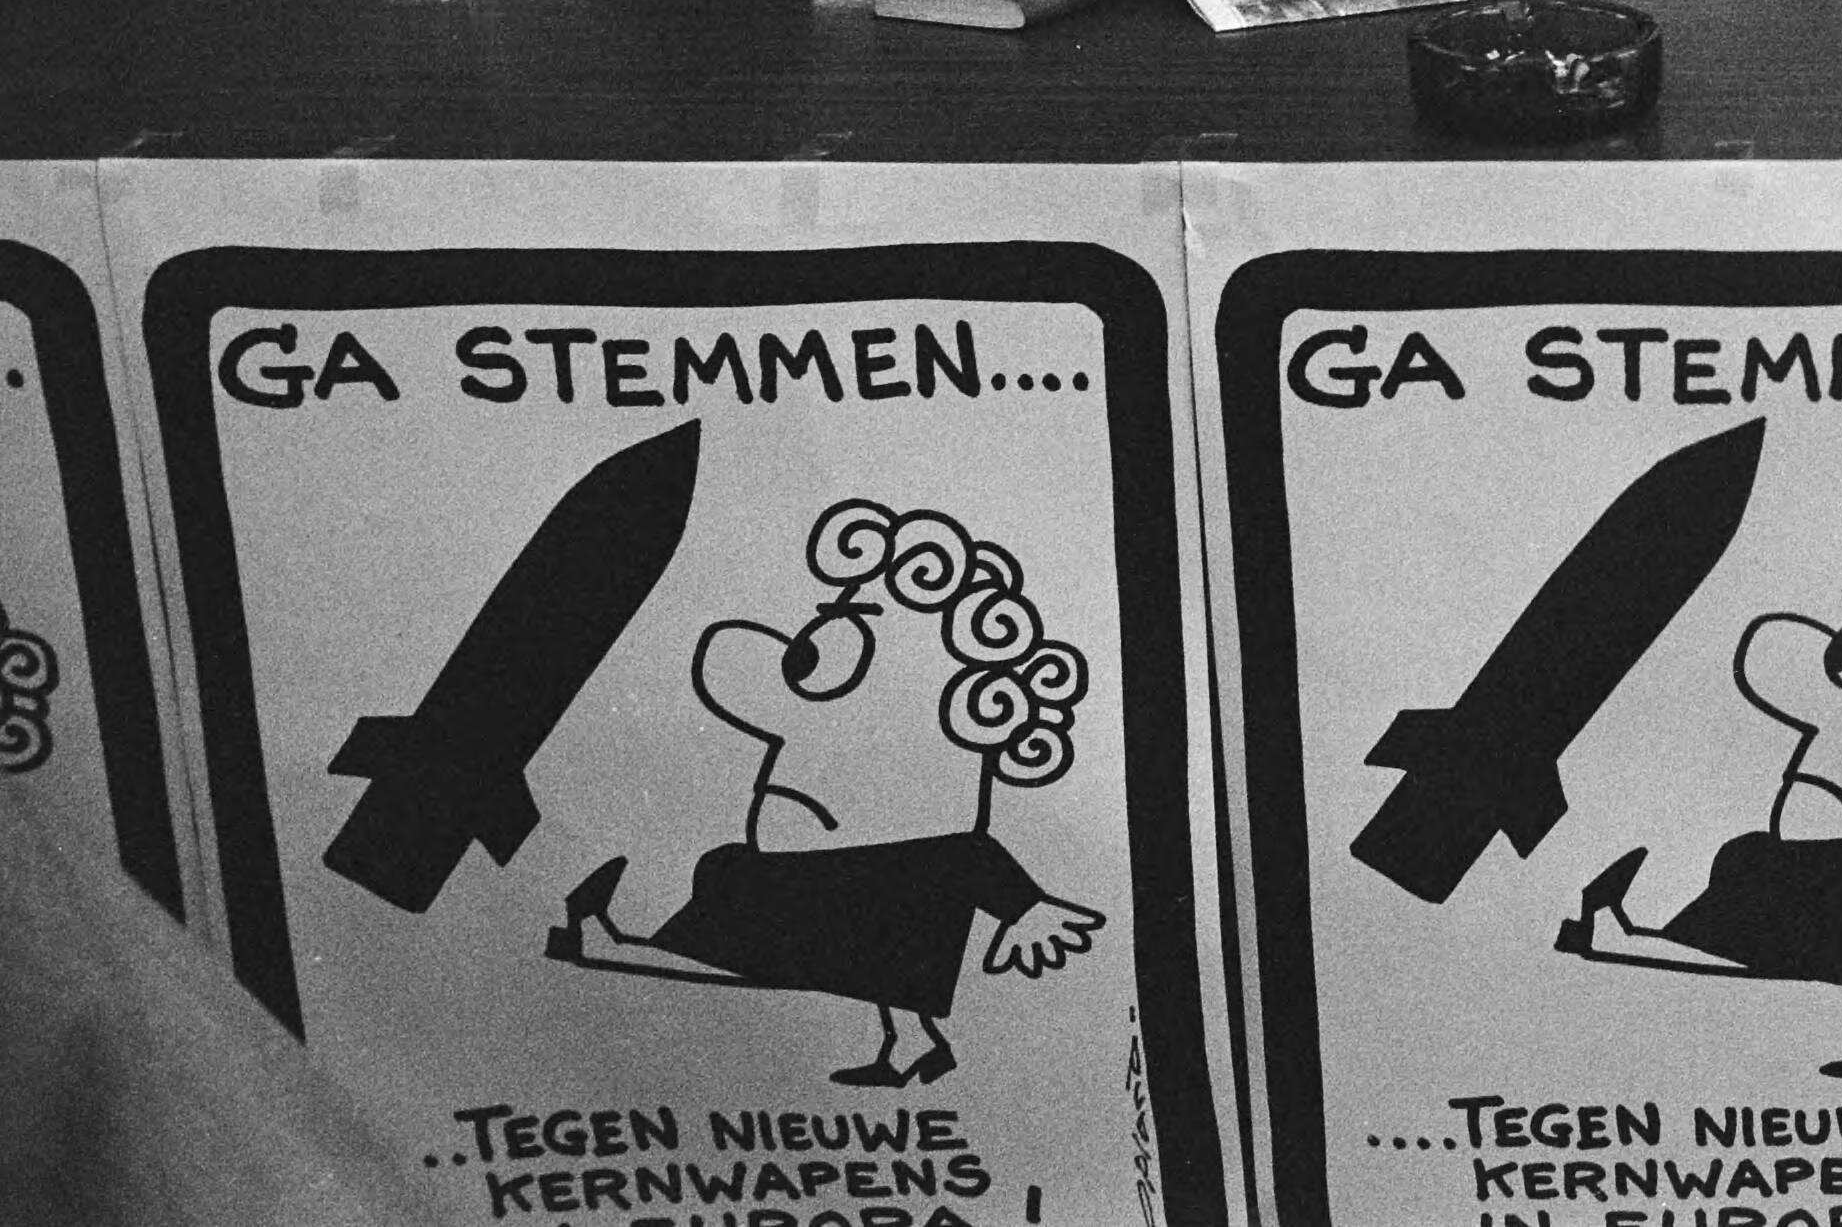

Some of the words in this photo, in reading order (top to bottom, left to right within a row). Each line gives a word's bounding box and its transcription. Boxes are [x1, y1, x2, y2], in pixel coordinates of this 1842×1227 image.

[218, 324, 400, 409] GA
[1286, 325, 1465, 409] GA
[709, 1109, 969, 1152] NIEUWE
[485, 1153, 992, 1217] KERNWAPENS
